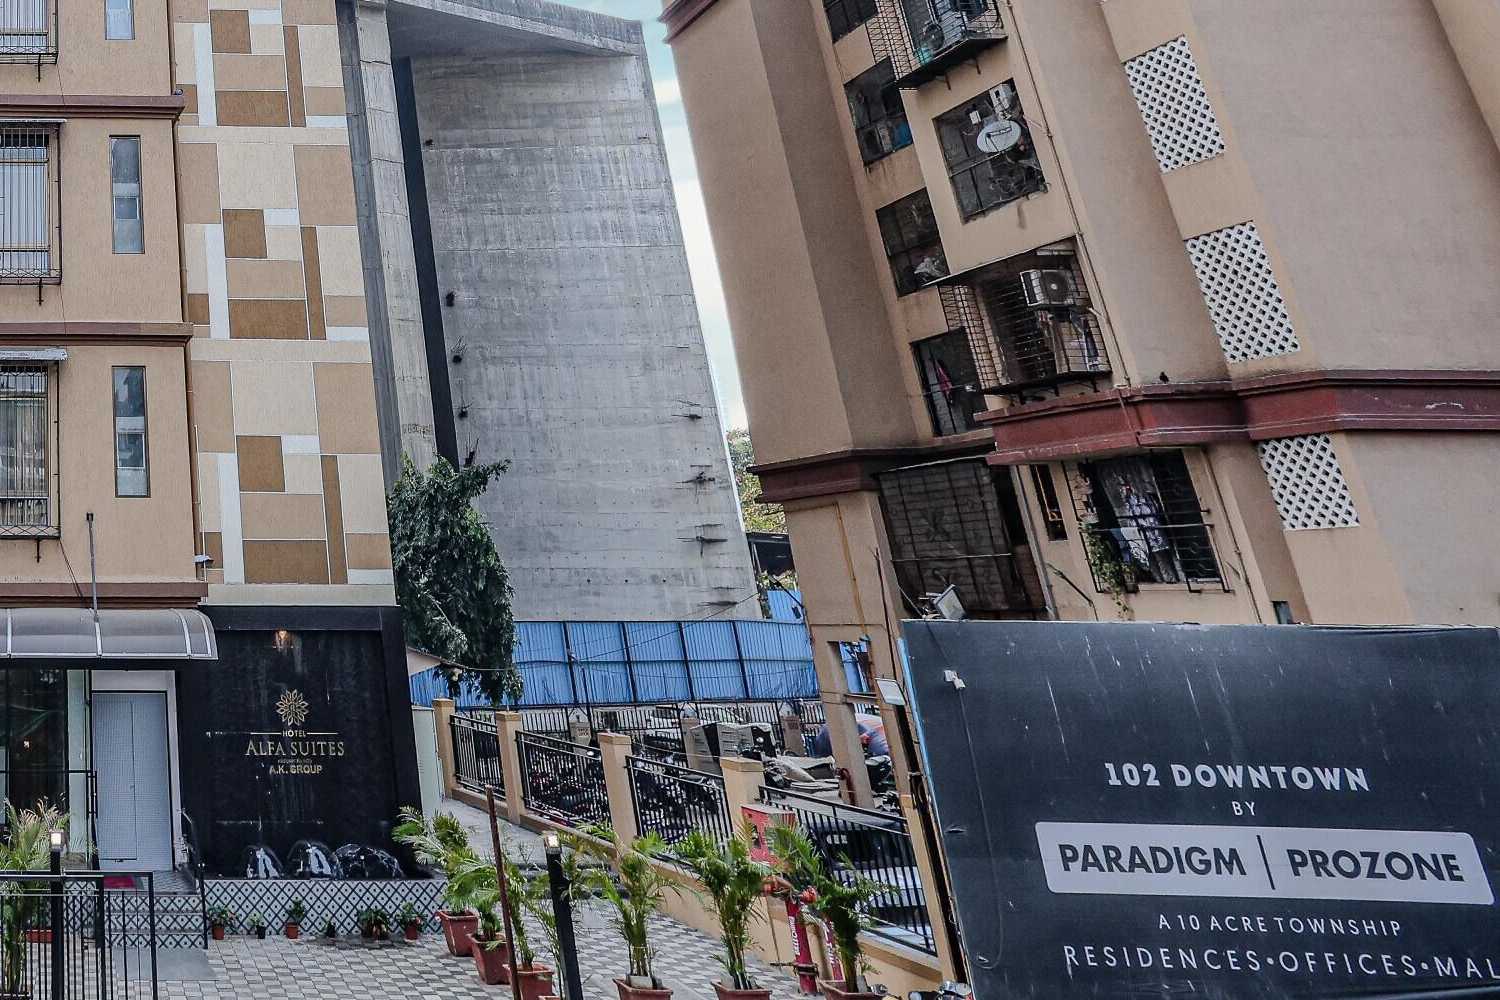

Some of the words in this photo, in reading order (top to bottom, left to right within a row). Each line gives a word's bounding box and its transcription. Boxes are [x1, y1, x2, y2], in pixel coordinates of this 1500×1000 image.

[245, 739, 286, 756] ALFA
[290, 741, 345, 756] SUITES
[290, 765, 323, 774] GROUP
[1104, 762, 1160, 787] 102
[1170, 764, 1370, 792] DOWNTOWN
[1232, 800, 1257, 818] BY
[1059, 844, 1247, 876] PARADIGM
[1286, 849, 1465, 882] PROZONE
[1158, 913, 1171, 931] A
[1177, 913, 1201, 931] 10
[1209, 915, 1268, 934] ACRE
[1274, 916, 1401, 938] TOWNSHIP
